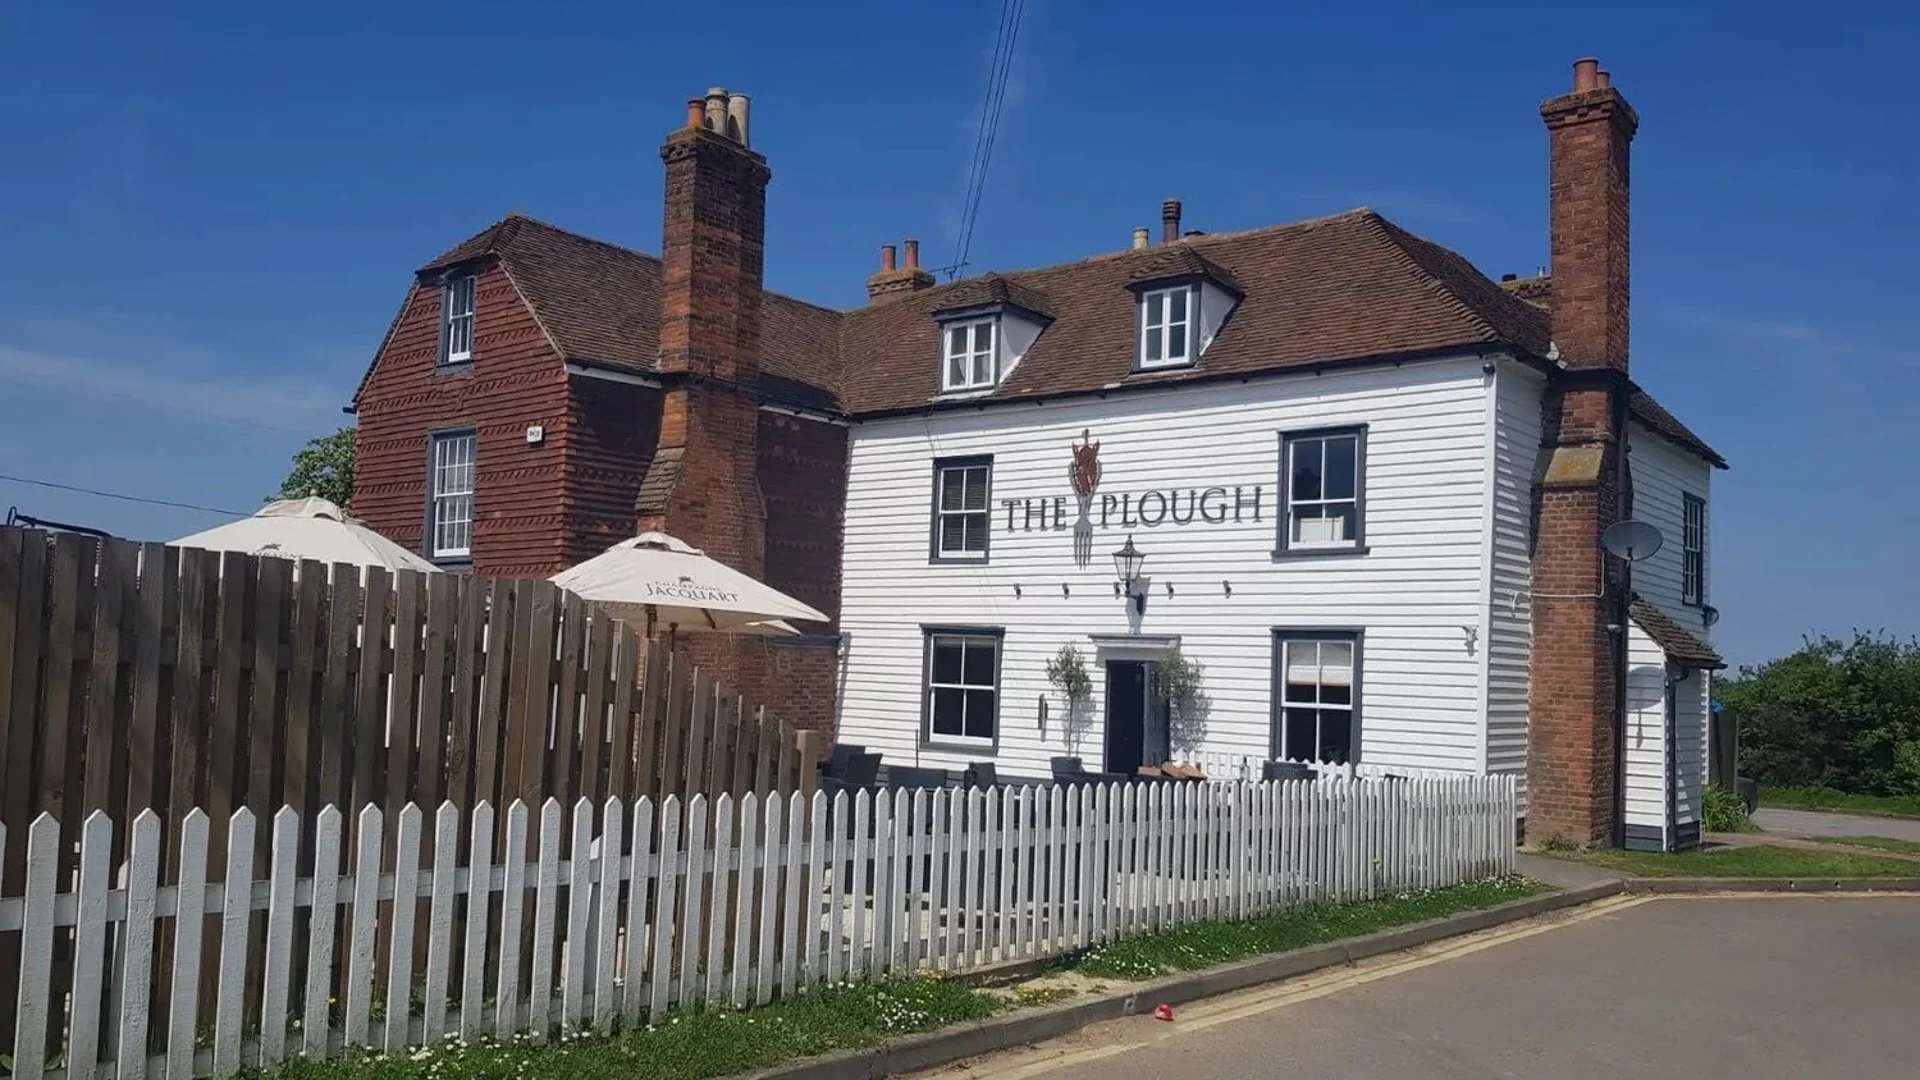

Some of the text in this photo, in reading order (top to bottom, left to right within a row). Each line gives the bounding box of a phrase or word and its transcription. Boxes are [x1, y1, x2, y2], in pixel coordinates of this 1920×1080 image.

[1001, 486, 1263, 532] THE PLOUGH
[646, 583, 738, 602] JACQUART
